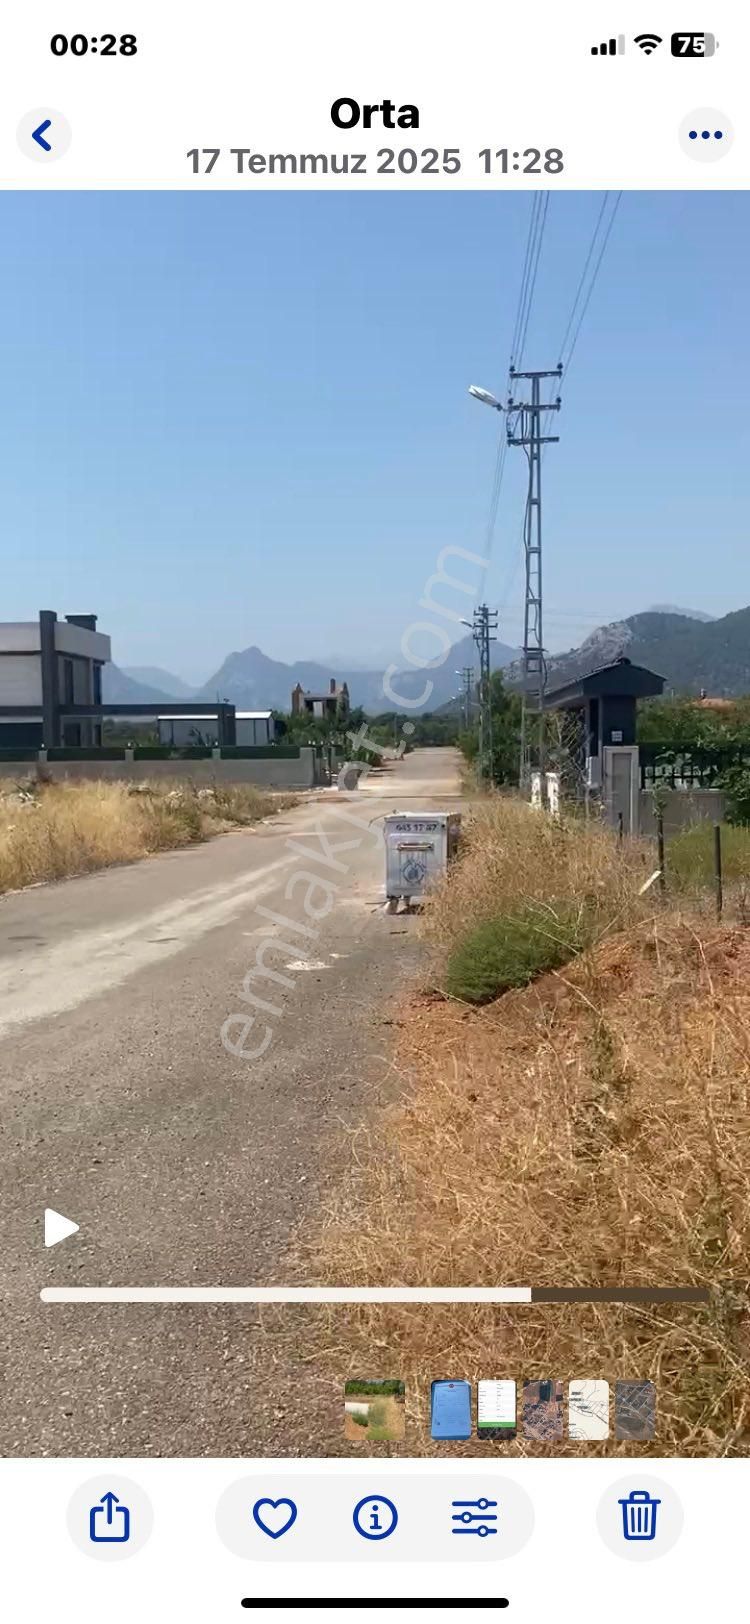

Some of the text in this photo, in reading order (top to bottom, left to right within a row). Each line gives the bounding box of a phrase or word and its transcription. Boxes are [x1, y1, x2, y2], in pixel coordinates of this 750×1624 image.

[50, 33, 138, 57] 00:28
[677, 35, 706, 54] 75
[330, 97, 420, 130] Orta
[186, 147, 565, 175] 17 Temmuz 2025 11:28
